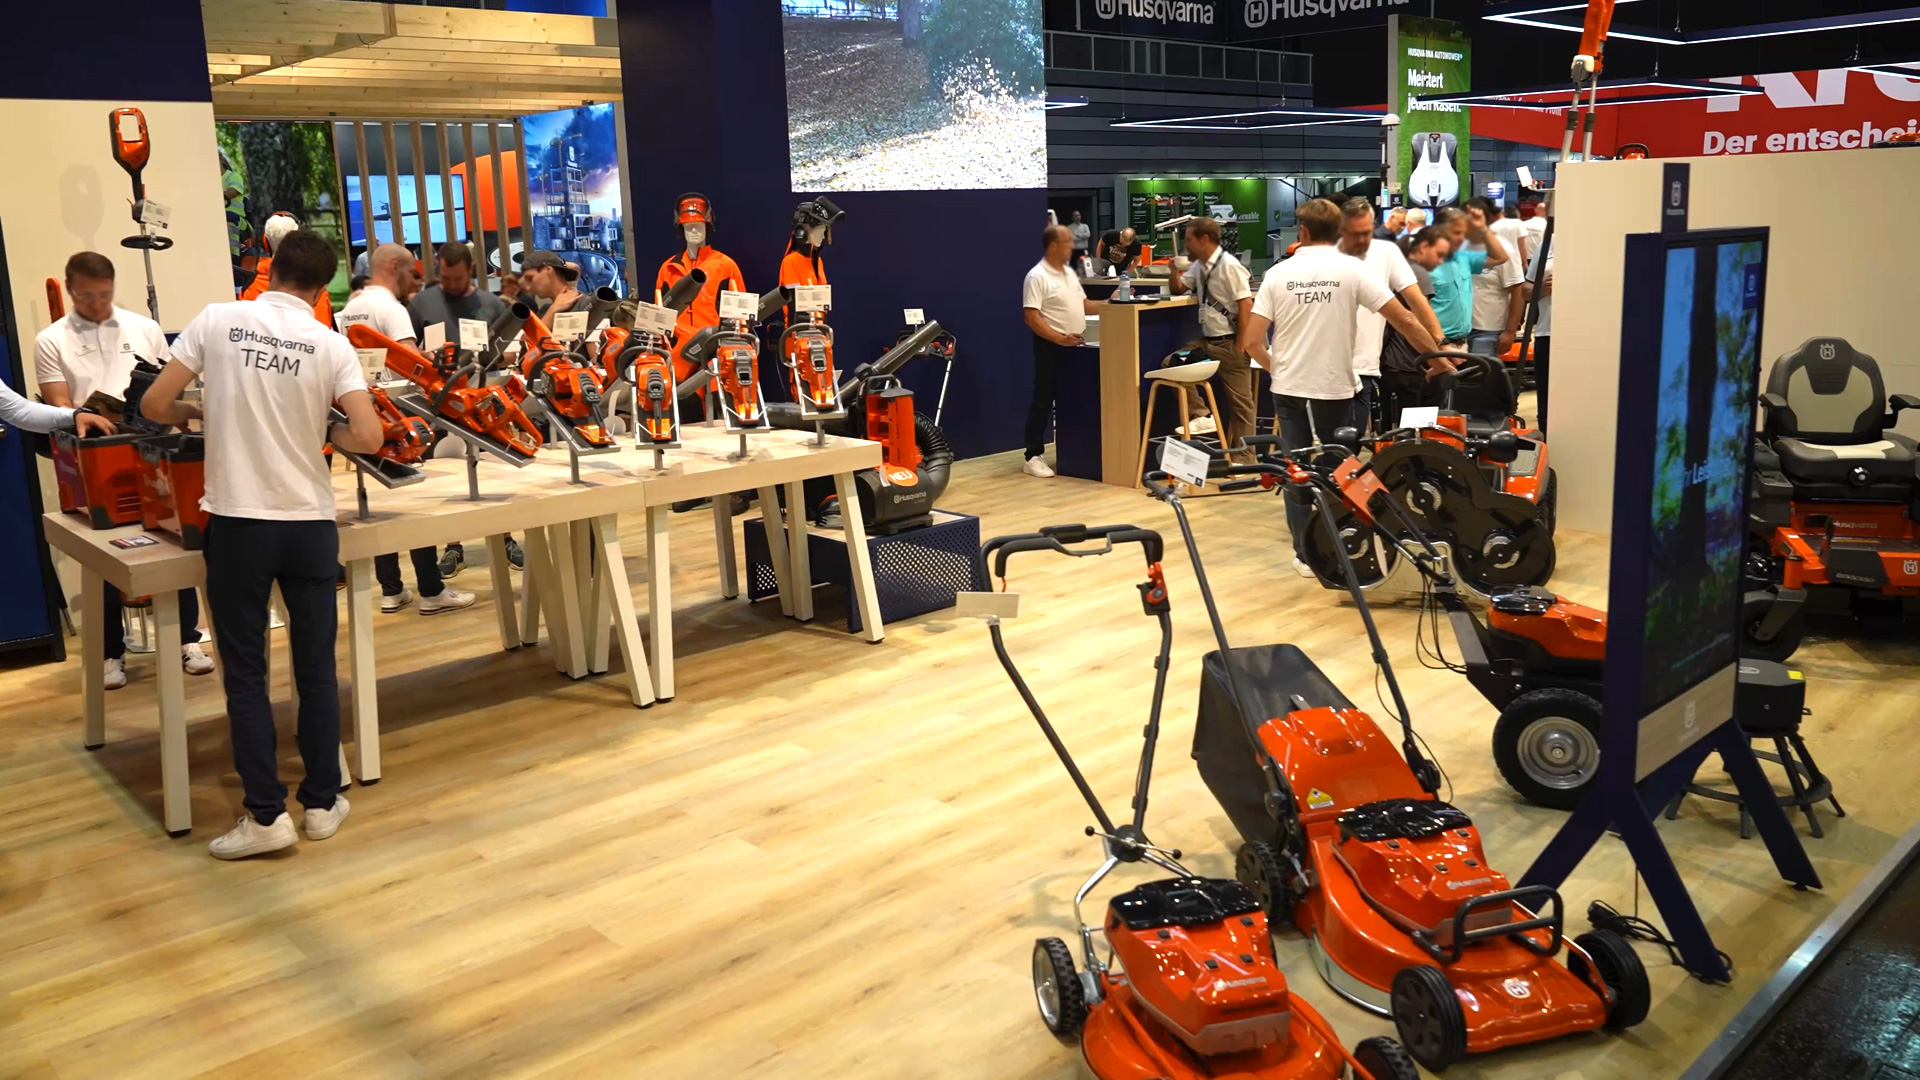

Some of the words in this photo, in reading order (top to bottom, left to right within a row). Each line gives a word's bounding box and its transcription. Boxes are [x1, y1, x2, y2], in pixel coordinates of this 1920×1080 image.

[1118, 0, 1214, 24] Husqvarna
[1271, 0, 1409, 20] Husqva
[1407, 68, 1444, 89] Meistert
[1703, 131, 1758, 155] Der
[1765, 118, 1920, 151] entschei
[1295, 280, 1340, 289] Husqvarna
[1294, 291, 1332, 305] TEAM
[244, 329, 316, 355] Husqvarna
[241, 348, 301, 377] TEAM
[888, 470, 913, 482] NEU
